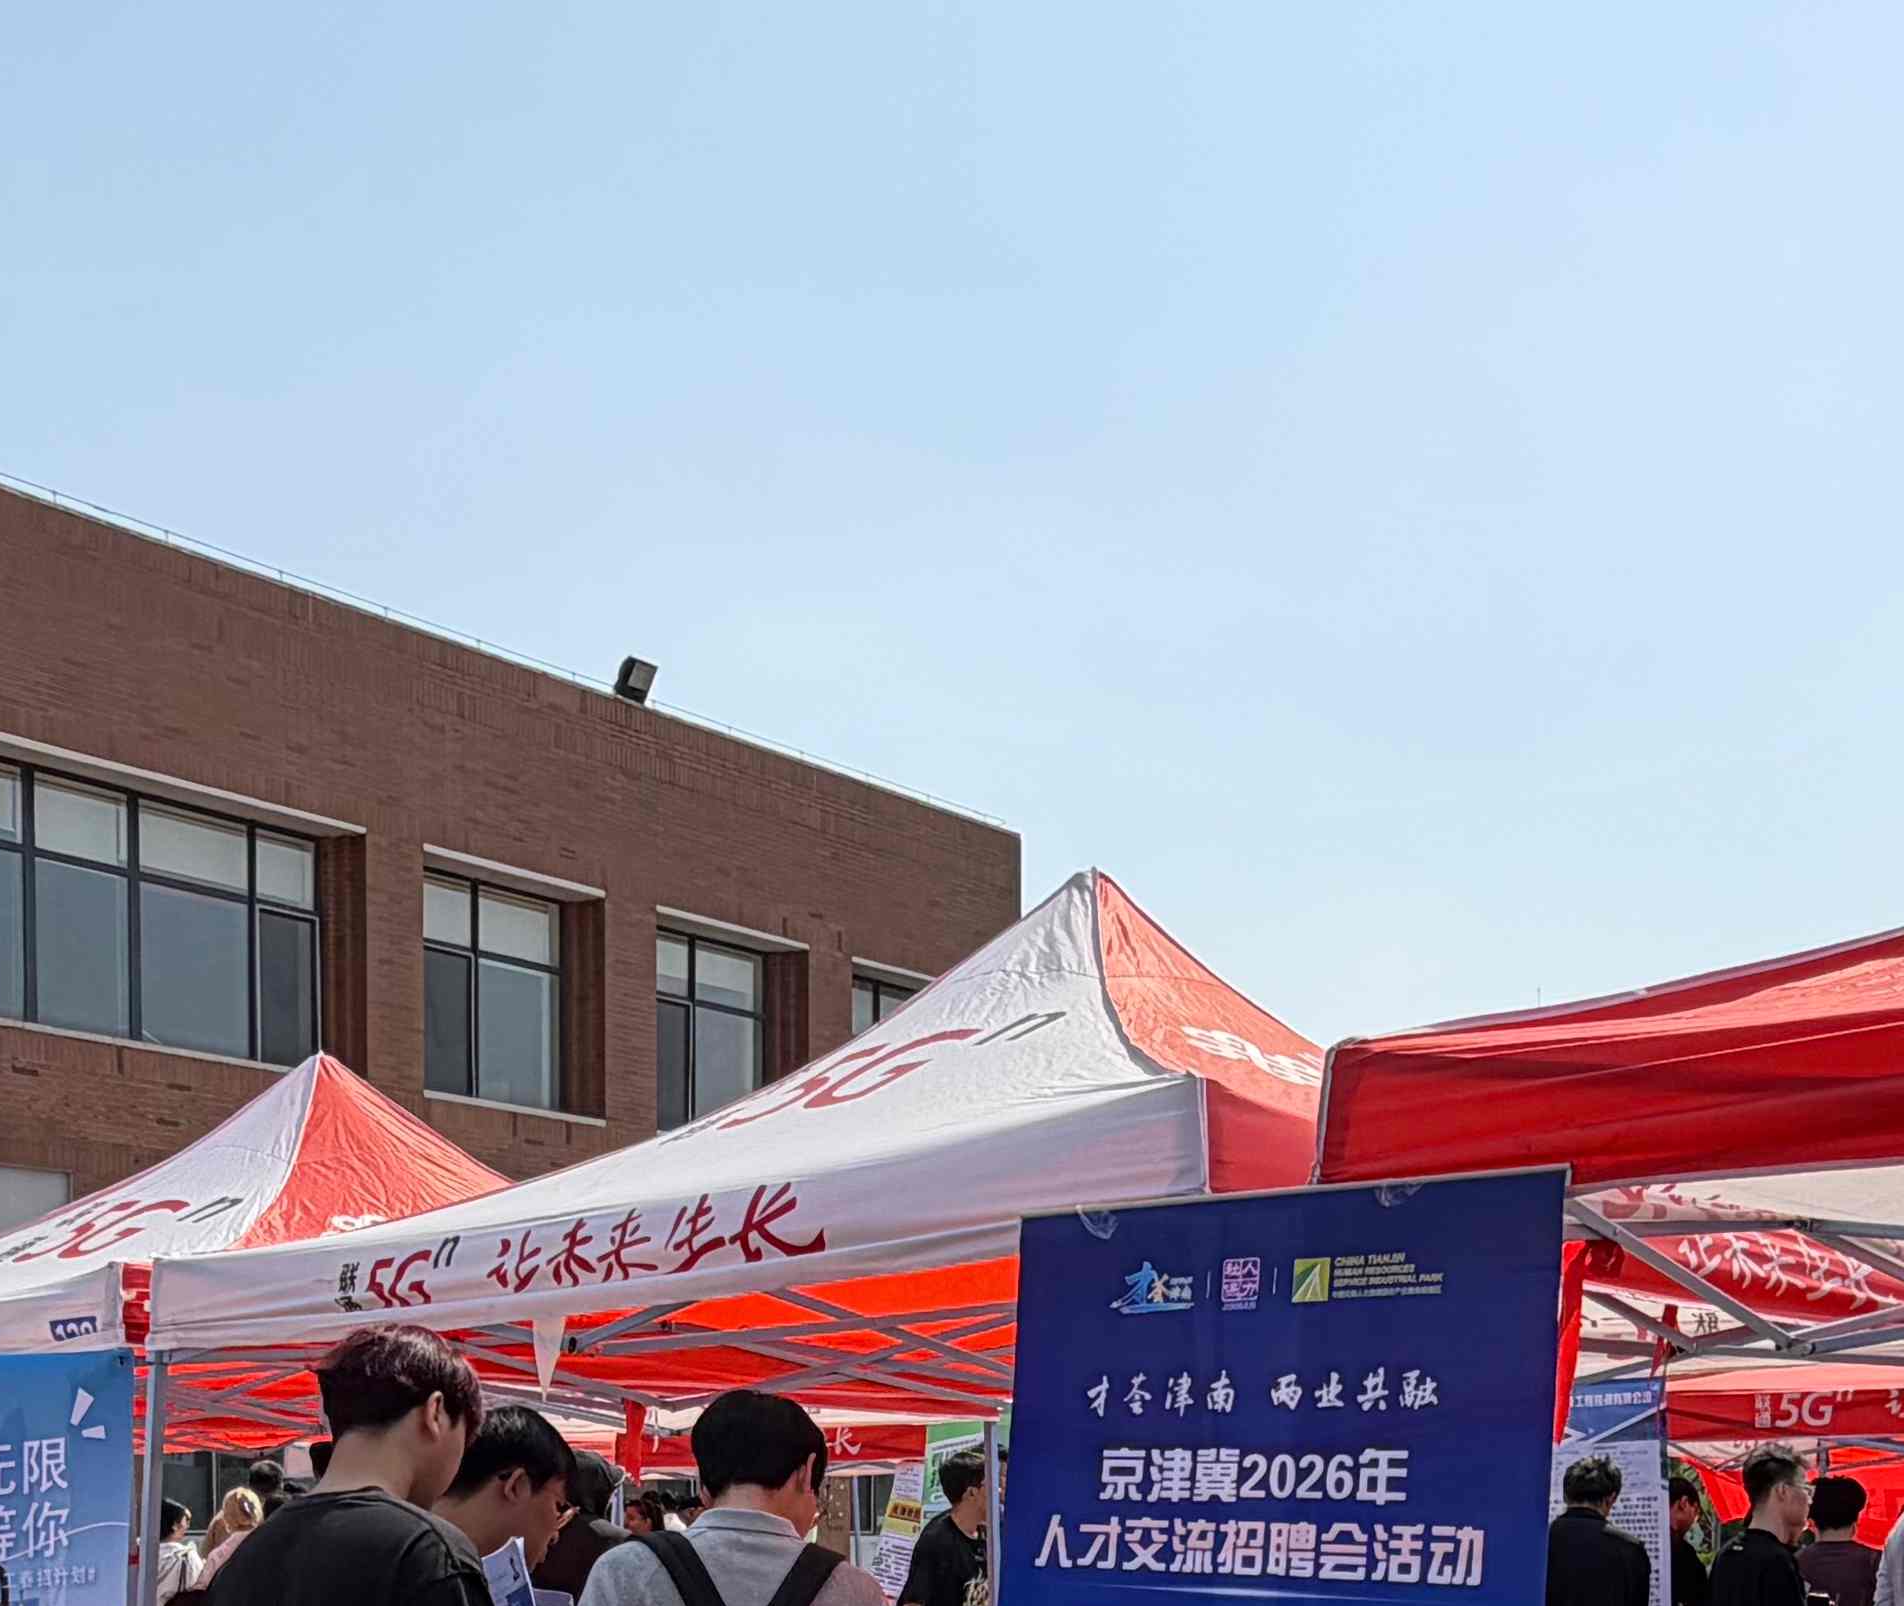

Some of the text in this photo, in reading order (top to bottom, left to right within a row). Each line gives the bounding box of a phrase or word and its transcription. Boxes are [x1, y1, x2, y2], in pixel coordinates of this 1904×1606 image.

[487, 1182, 827, 1294] 让未来生长
[1270, 1366, 1440, 1412] 两业共融
[1099, 1446, 1410, 1507] 京津冀2026年
[1033, 1513, 1485, 1587] 人才交流招聘会活动
